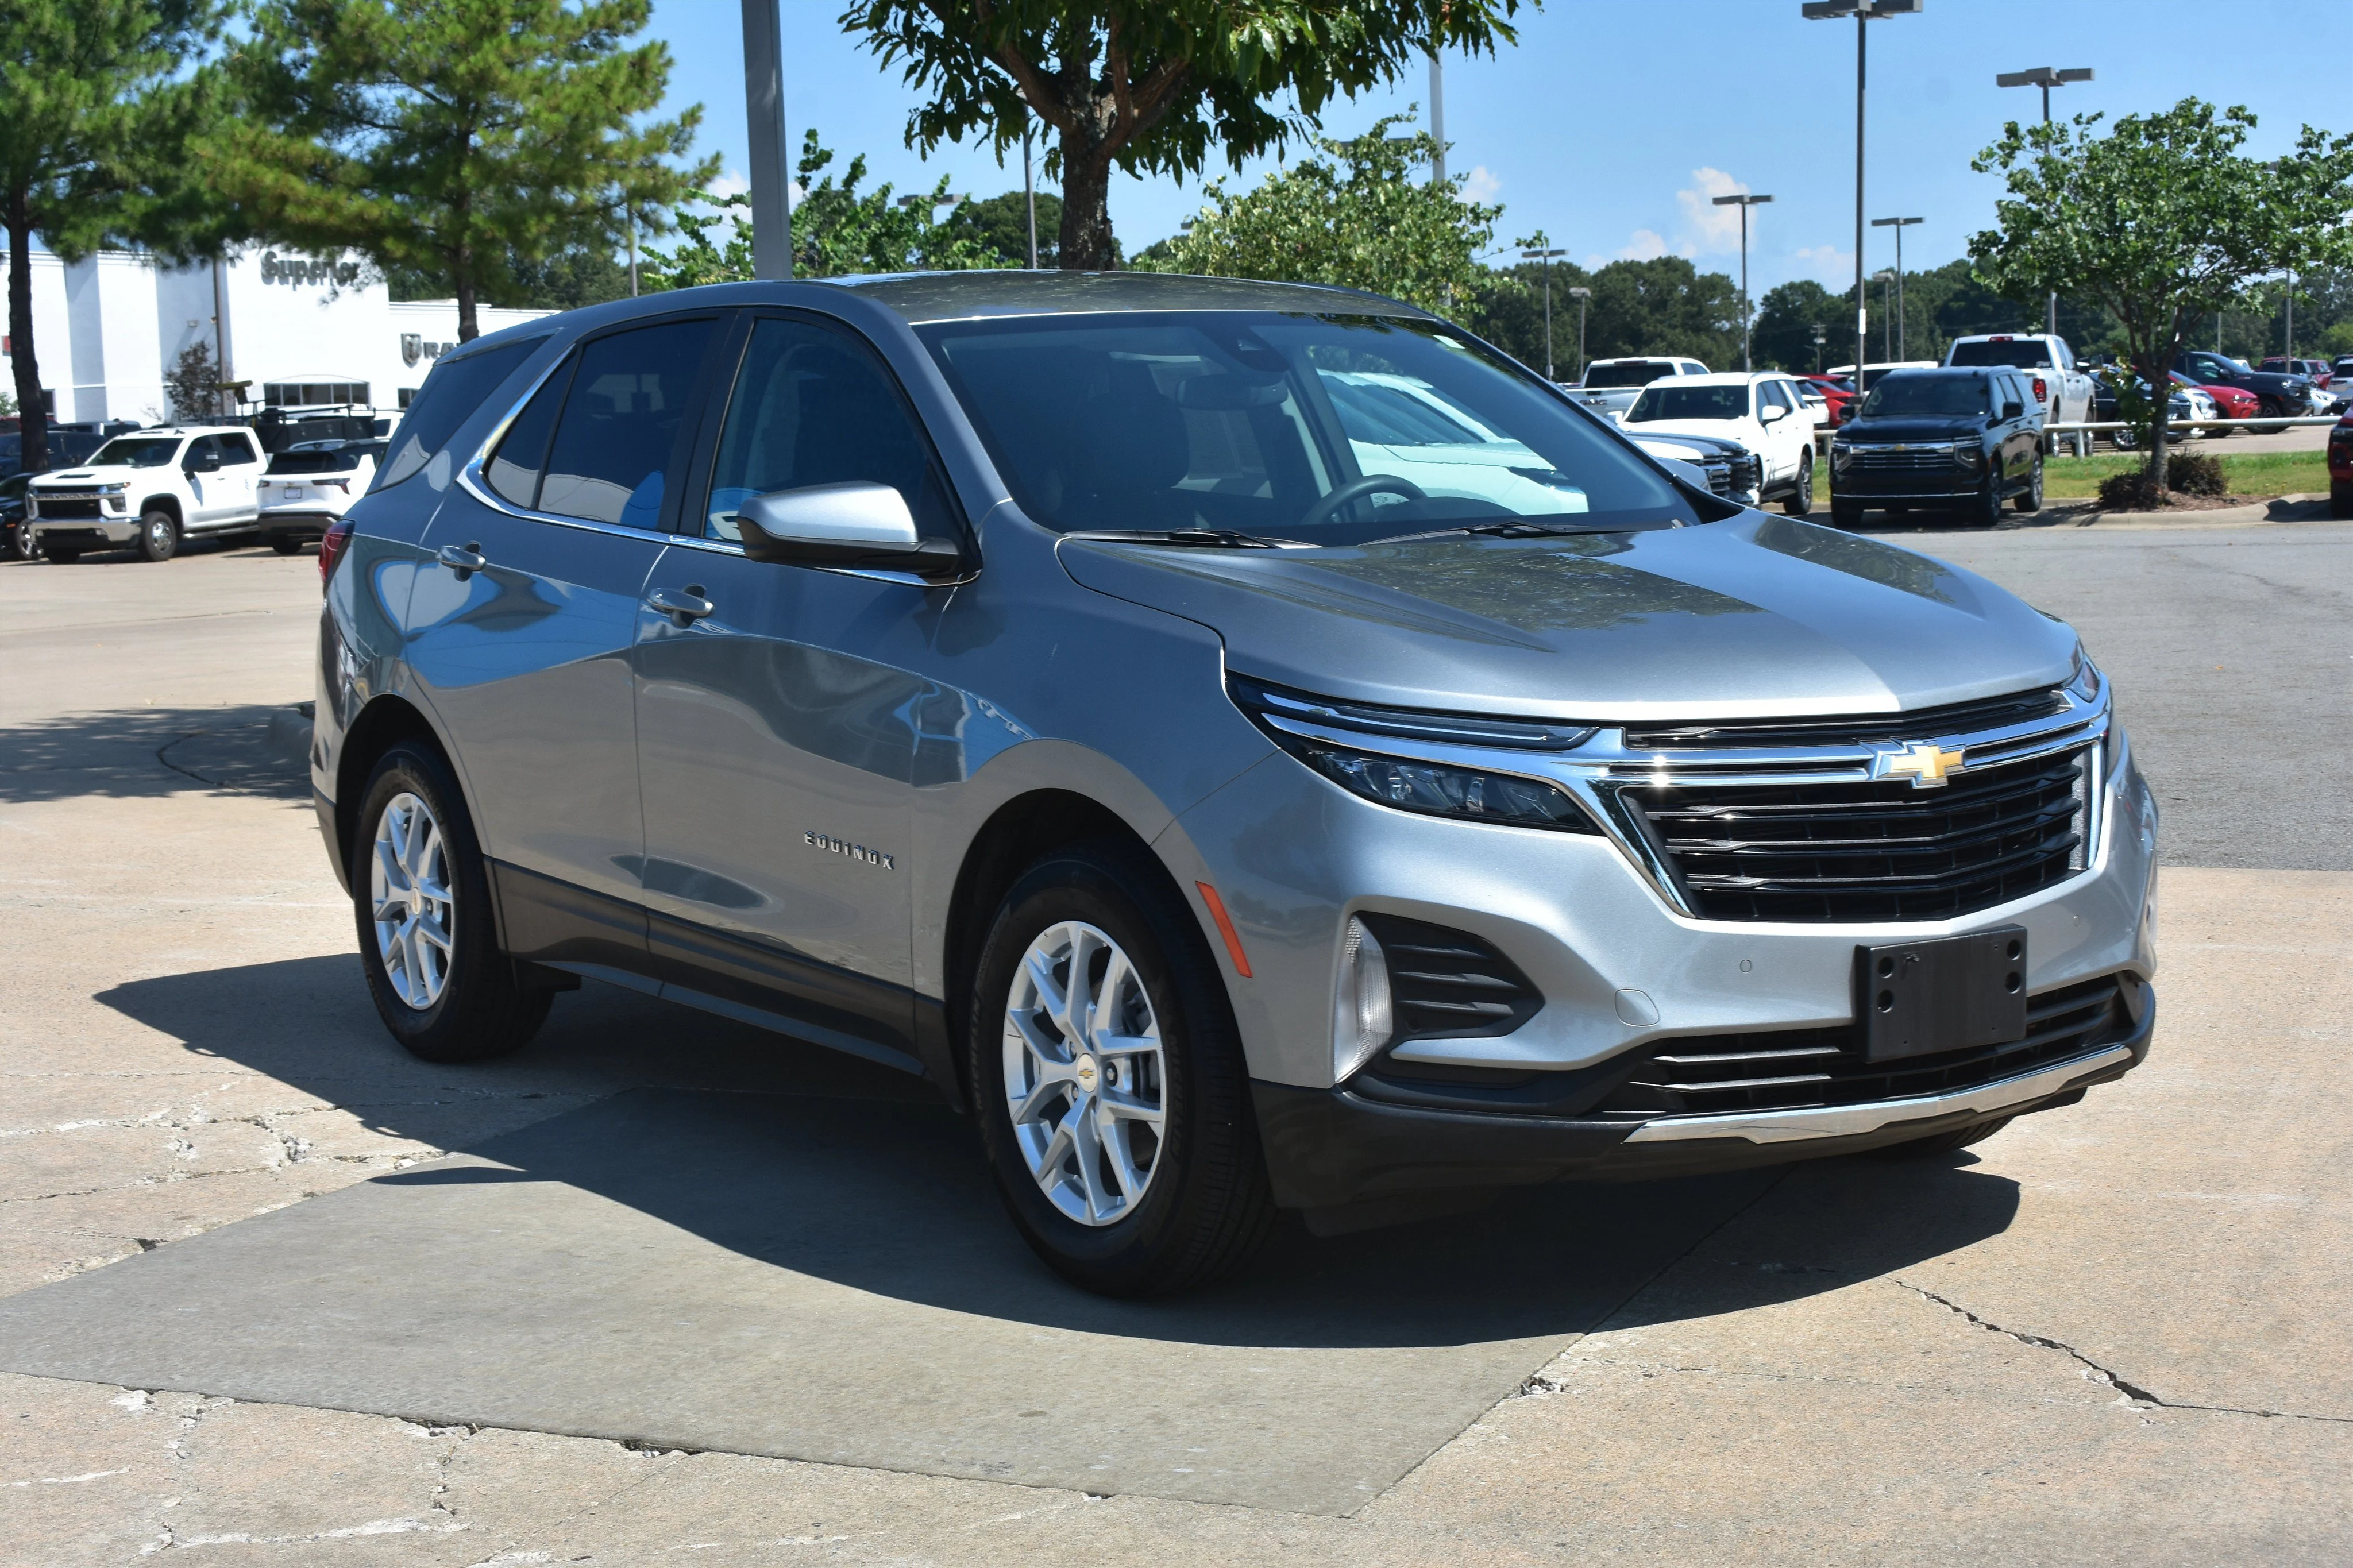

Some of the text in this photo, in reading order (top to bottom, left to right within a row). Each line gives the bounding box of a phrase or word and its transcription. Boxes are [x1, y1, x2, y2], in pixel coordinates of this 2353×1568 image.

[423, 342, 461, 359] RA
[804, 831, 894, 870] EQUINOX
[970, 997, 983, 1111] MICHELIN
